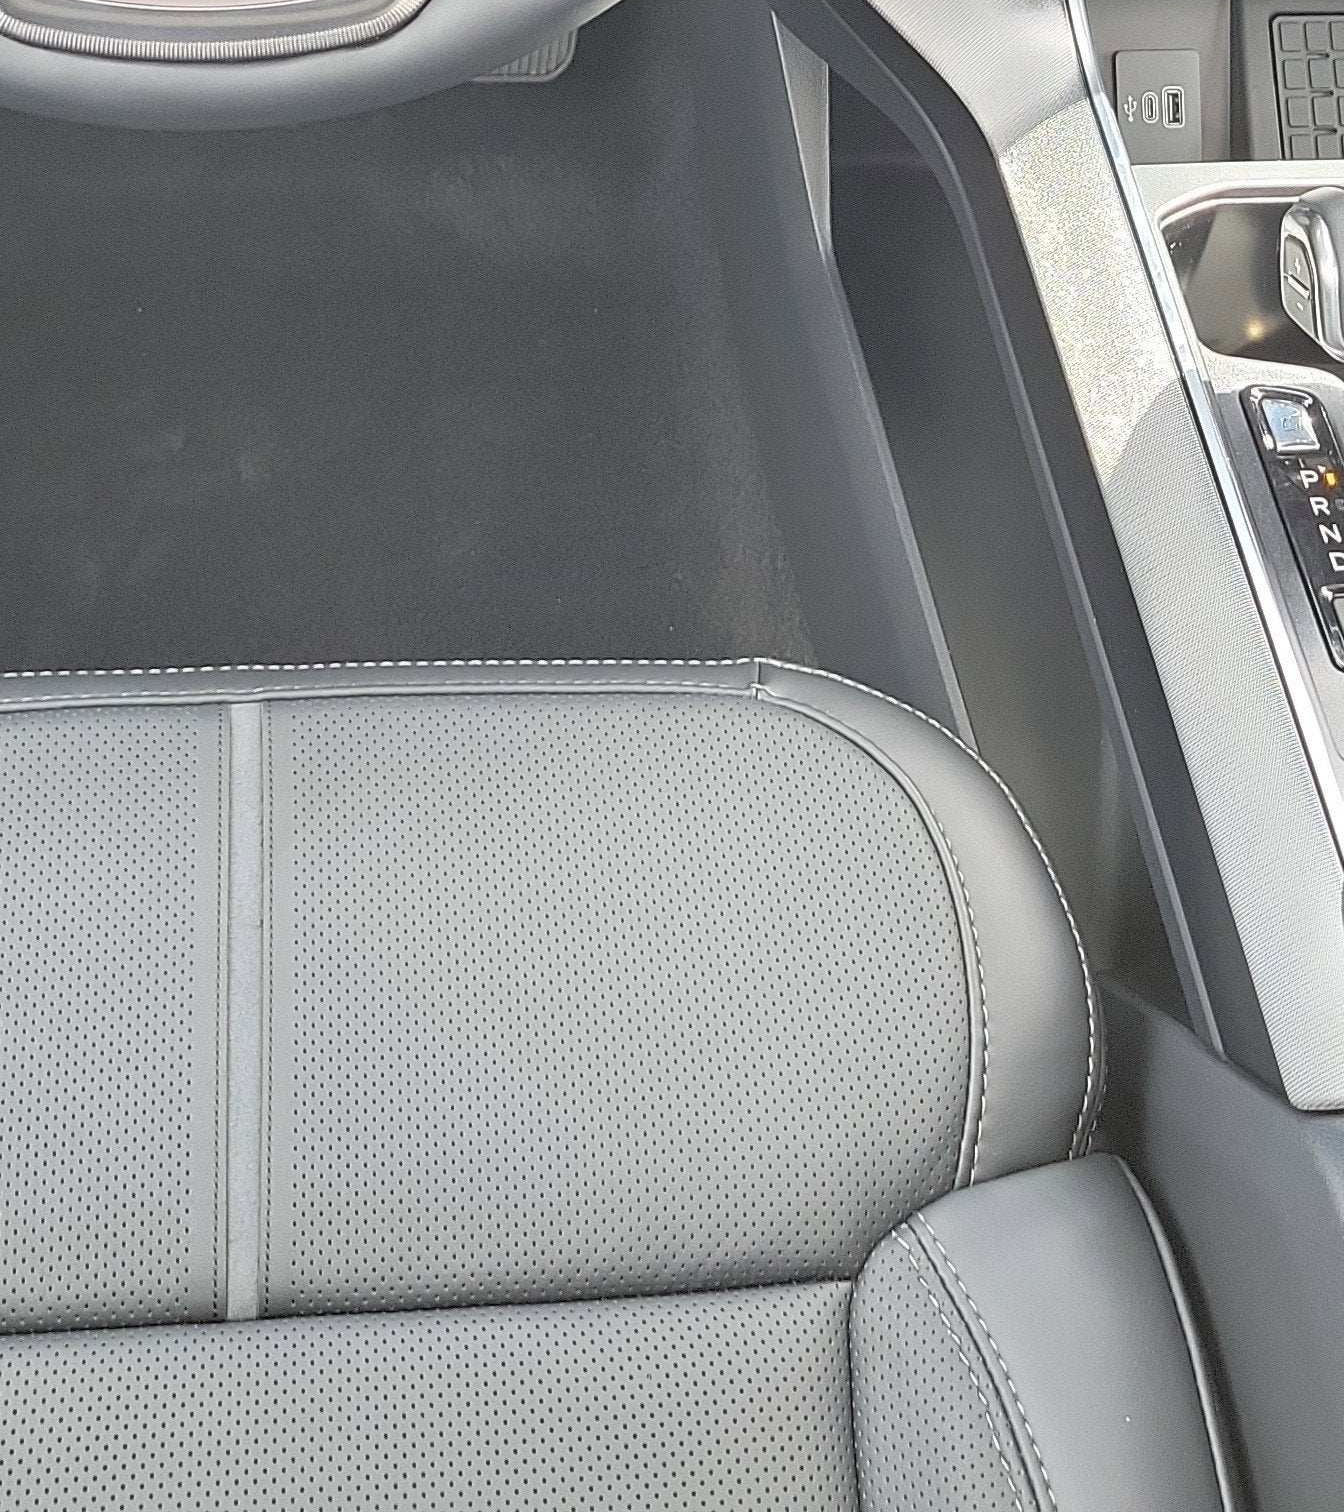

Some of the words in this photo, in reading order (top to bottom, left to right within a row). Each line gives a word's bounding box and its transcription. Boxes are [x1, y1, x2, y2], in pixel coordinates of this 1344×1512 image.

[1299, 469, 1320, 489] P
[1309, 496, 1331, 517] R
[1318, 523, 1343, 544] N
